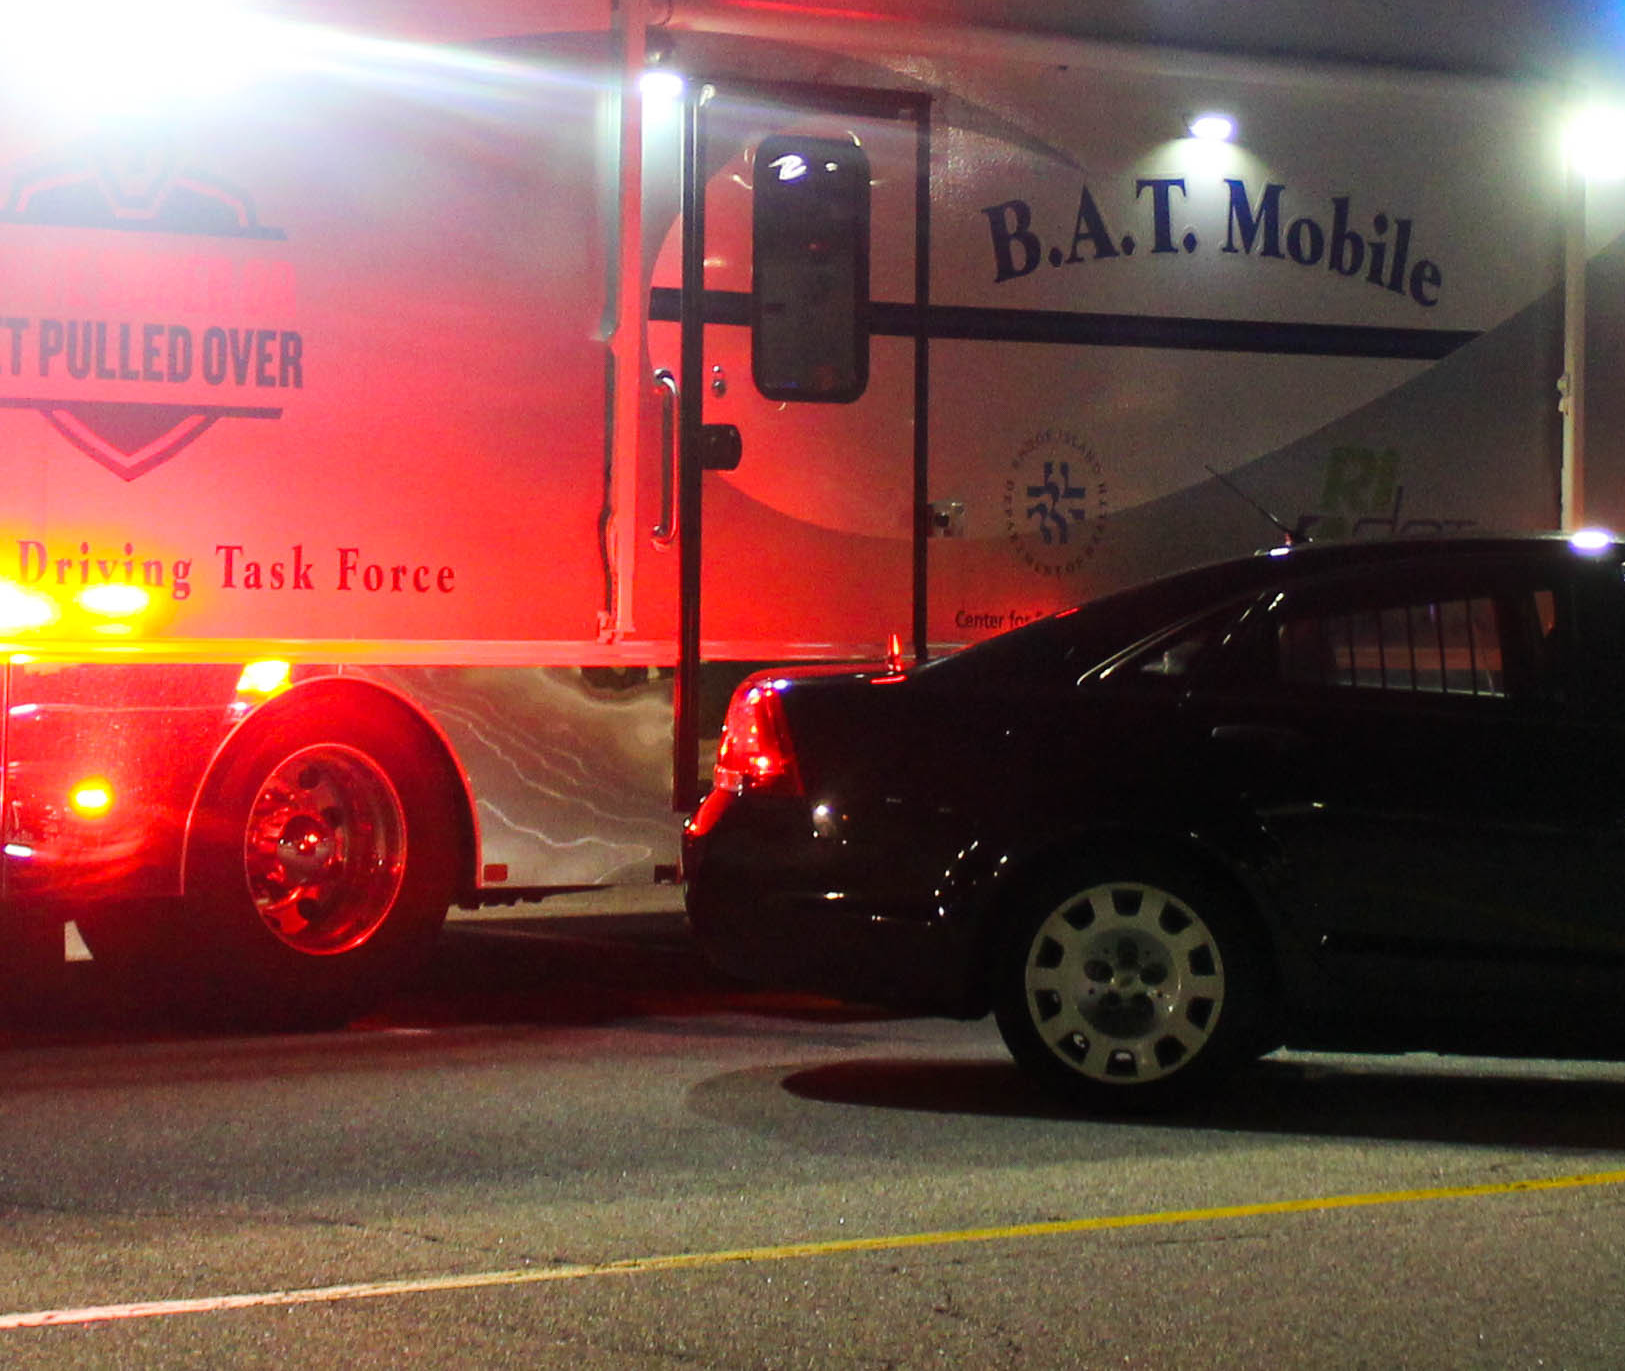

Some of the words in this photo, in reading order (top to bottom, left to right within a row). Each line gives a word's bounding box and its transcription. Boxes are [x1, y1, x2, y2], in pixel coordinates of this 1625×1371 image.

[981, 179, 1198, 284] B.A.T.
[1222, 179, 1443, 307] Mobile
[39, 319, 193, 384] PULLED
[202, 327, 304, 388] OVER
[18, 540, 193, 601] Driving
[215, 544, 315, 591] Task
[337, 548, 455, 593] Force
[955, 609, 1005, 629] Center
